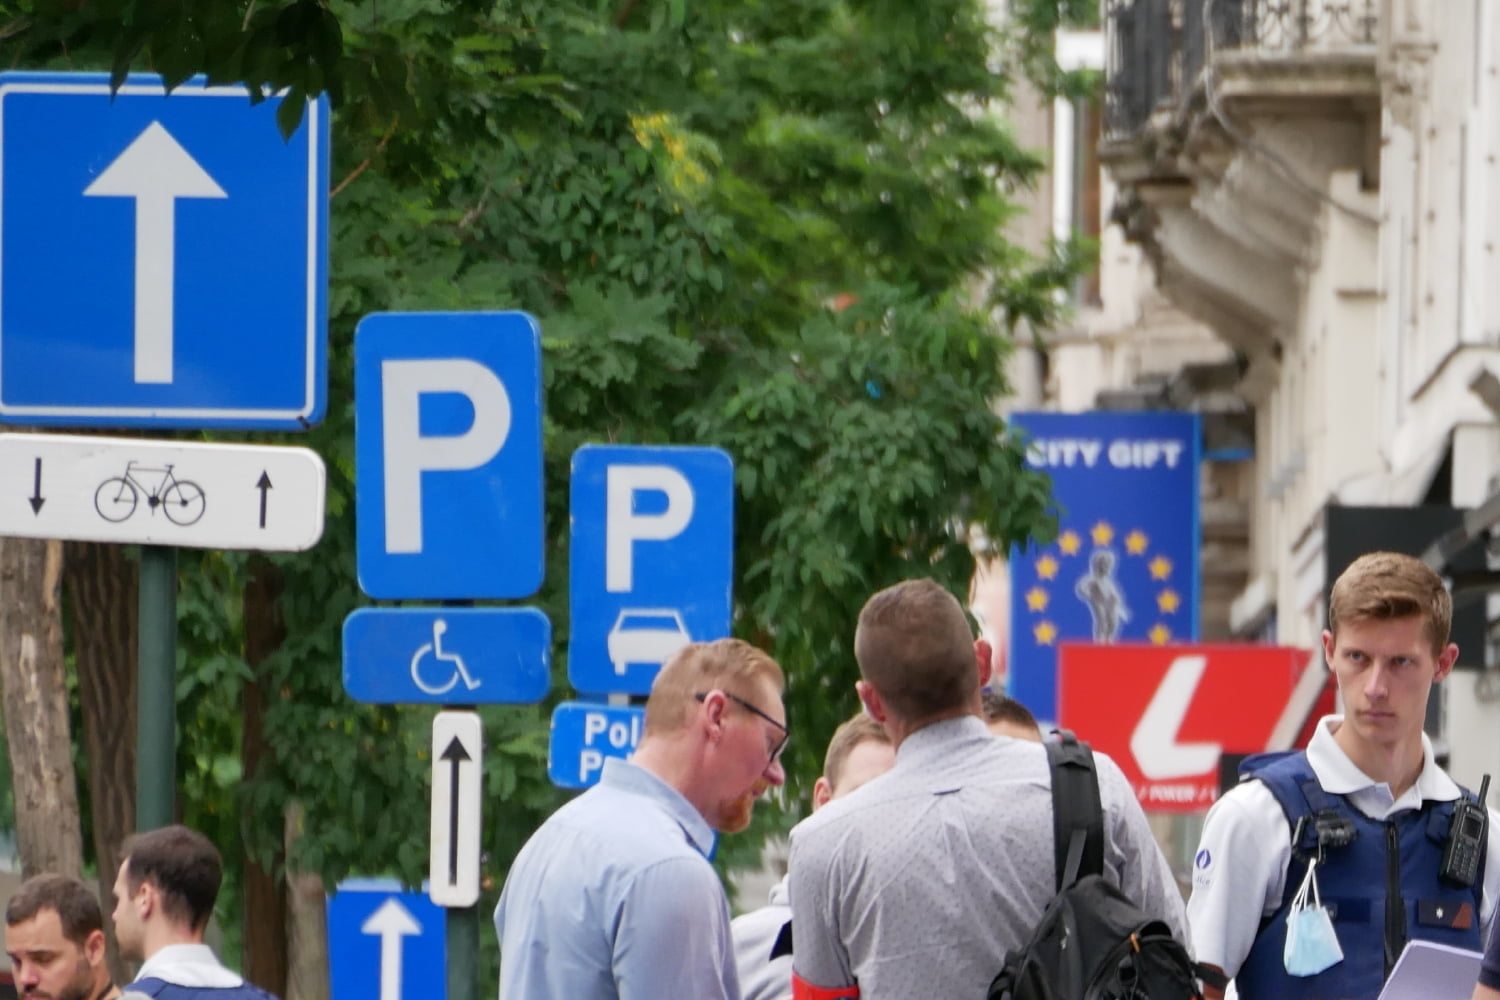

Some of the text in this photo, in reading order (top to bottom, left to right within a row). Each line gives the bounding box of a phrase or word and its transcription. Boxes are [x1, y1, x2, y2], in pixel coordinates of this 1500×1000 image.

[381, 358, 512, 555] P
[1025, 438, 1184, 470] CITY GIFT
[605, 464, 695, 593] P
[584, 711, 641, 749] Pol
